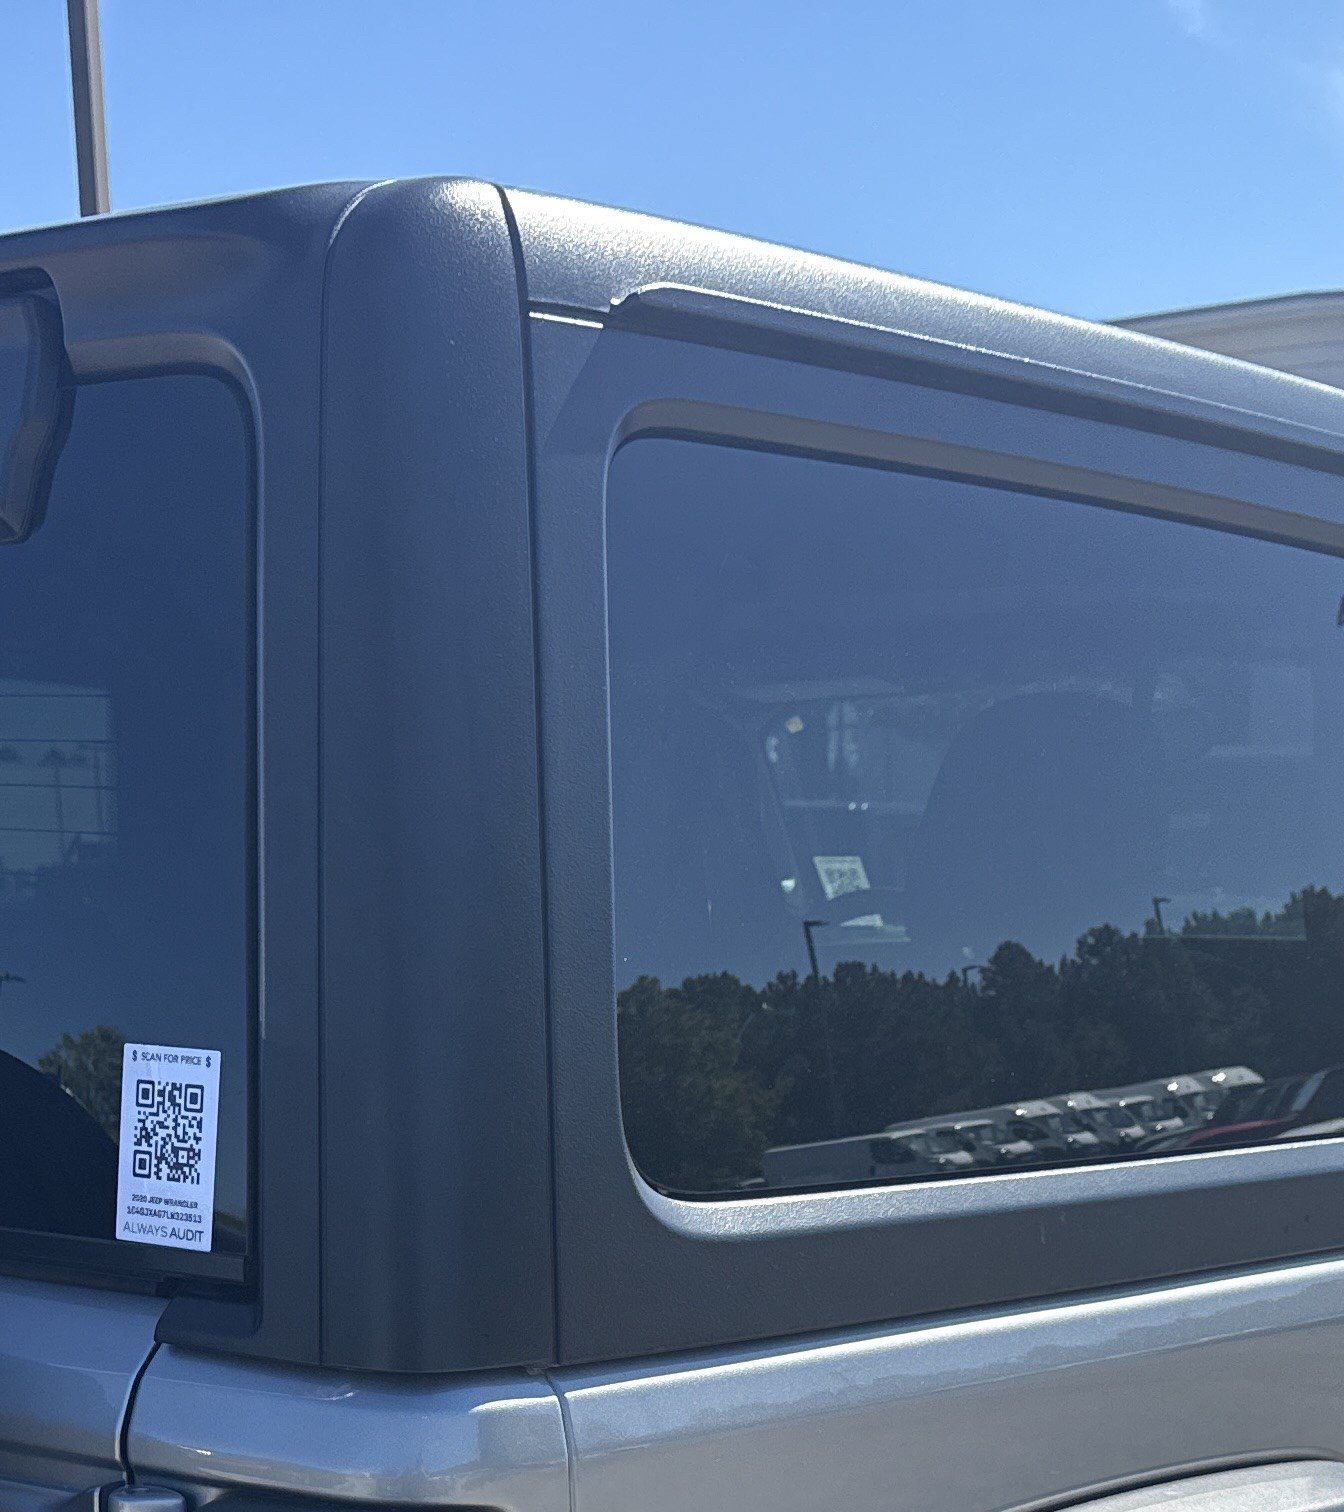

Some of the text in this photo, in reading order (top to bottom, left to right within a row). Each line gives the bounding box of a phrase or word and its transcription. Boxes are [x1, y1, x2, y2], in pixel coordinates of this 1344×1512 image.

[141, 1051, 162, 1063] SCAN
[163, 1053, 179, 1064] FOR
[180, 1055, 202, 1066] PRICE
[148, 1196, 163, 1206] JEEP
[163, 1197, 199, 1209] WRANGLER
[122, 1221, 205, 1243] ALWAYS AUDIT
